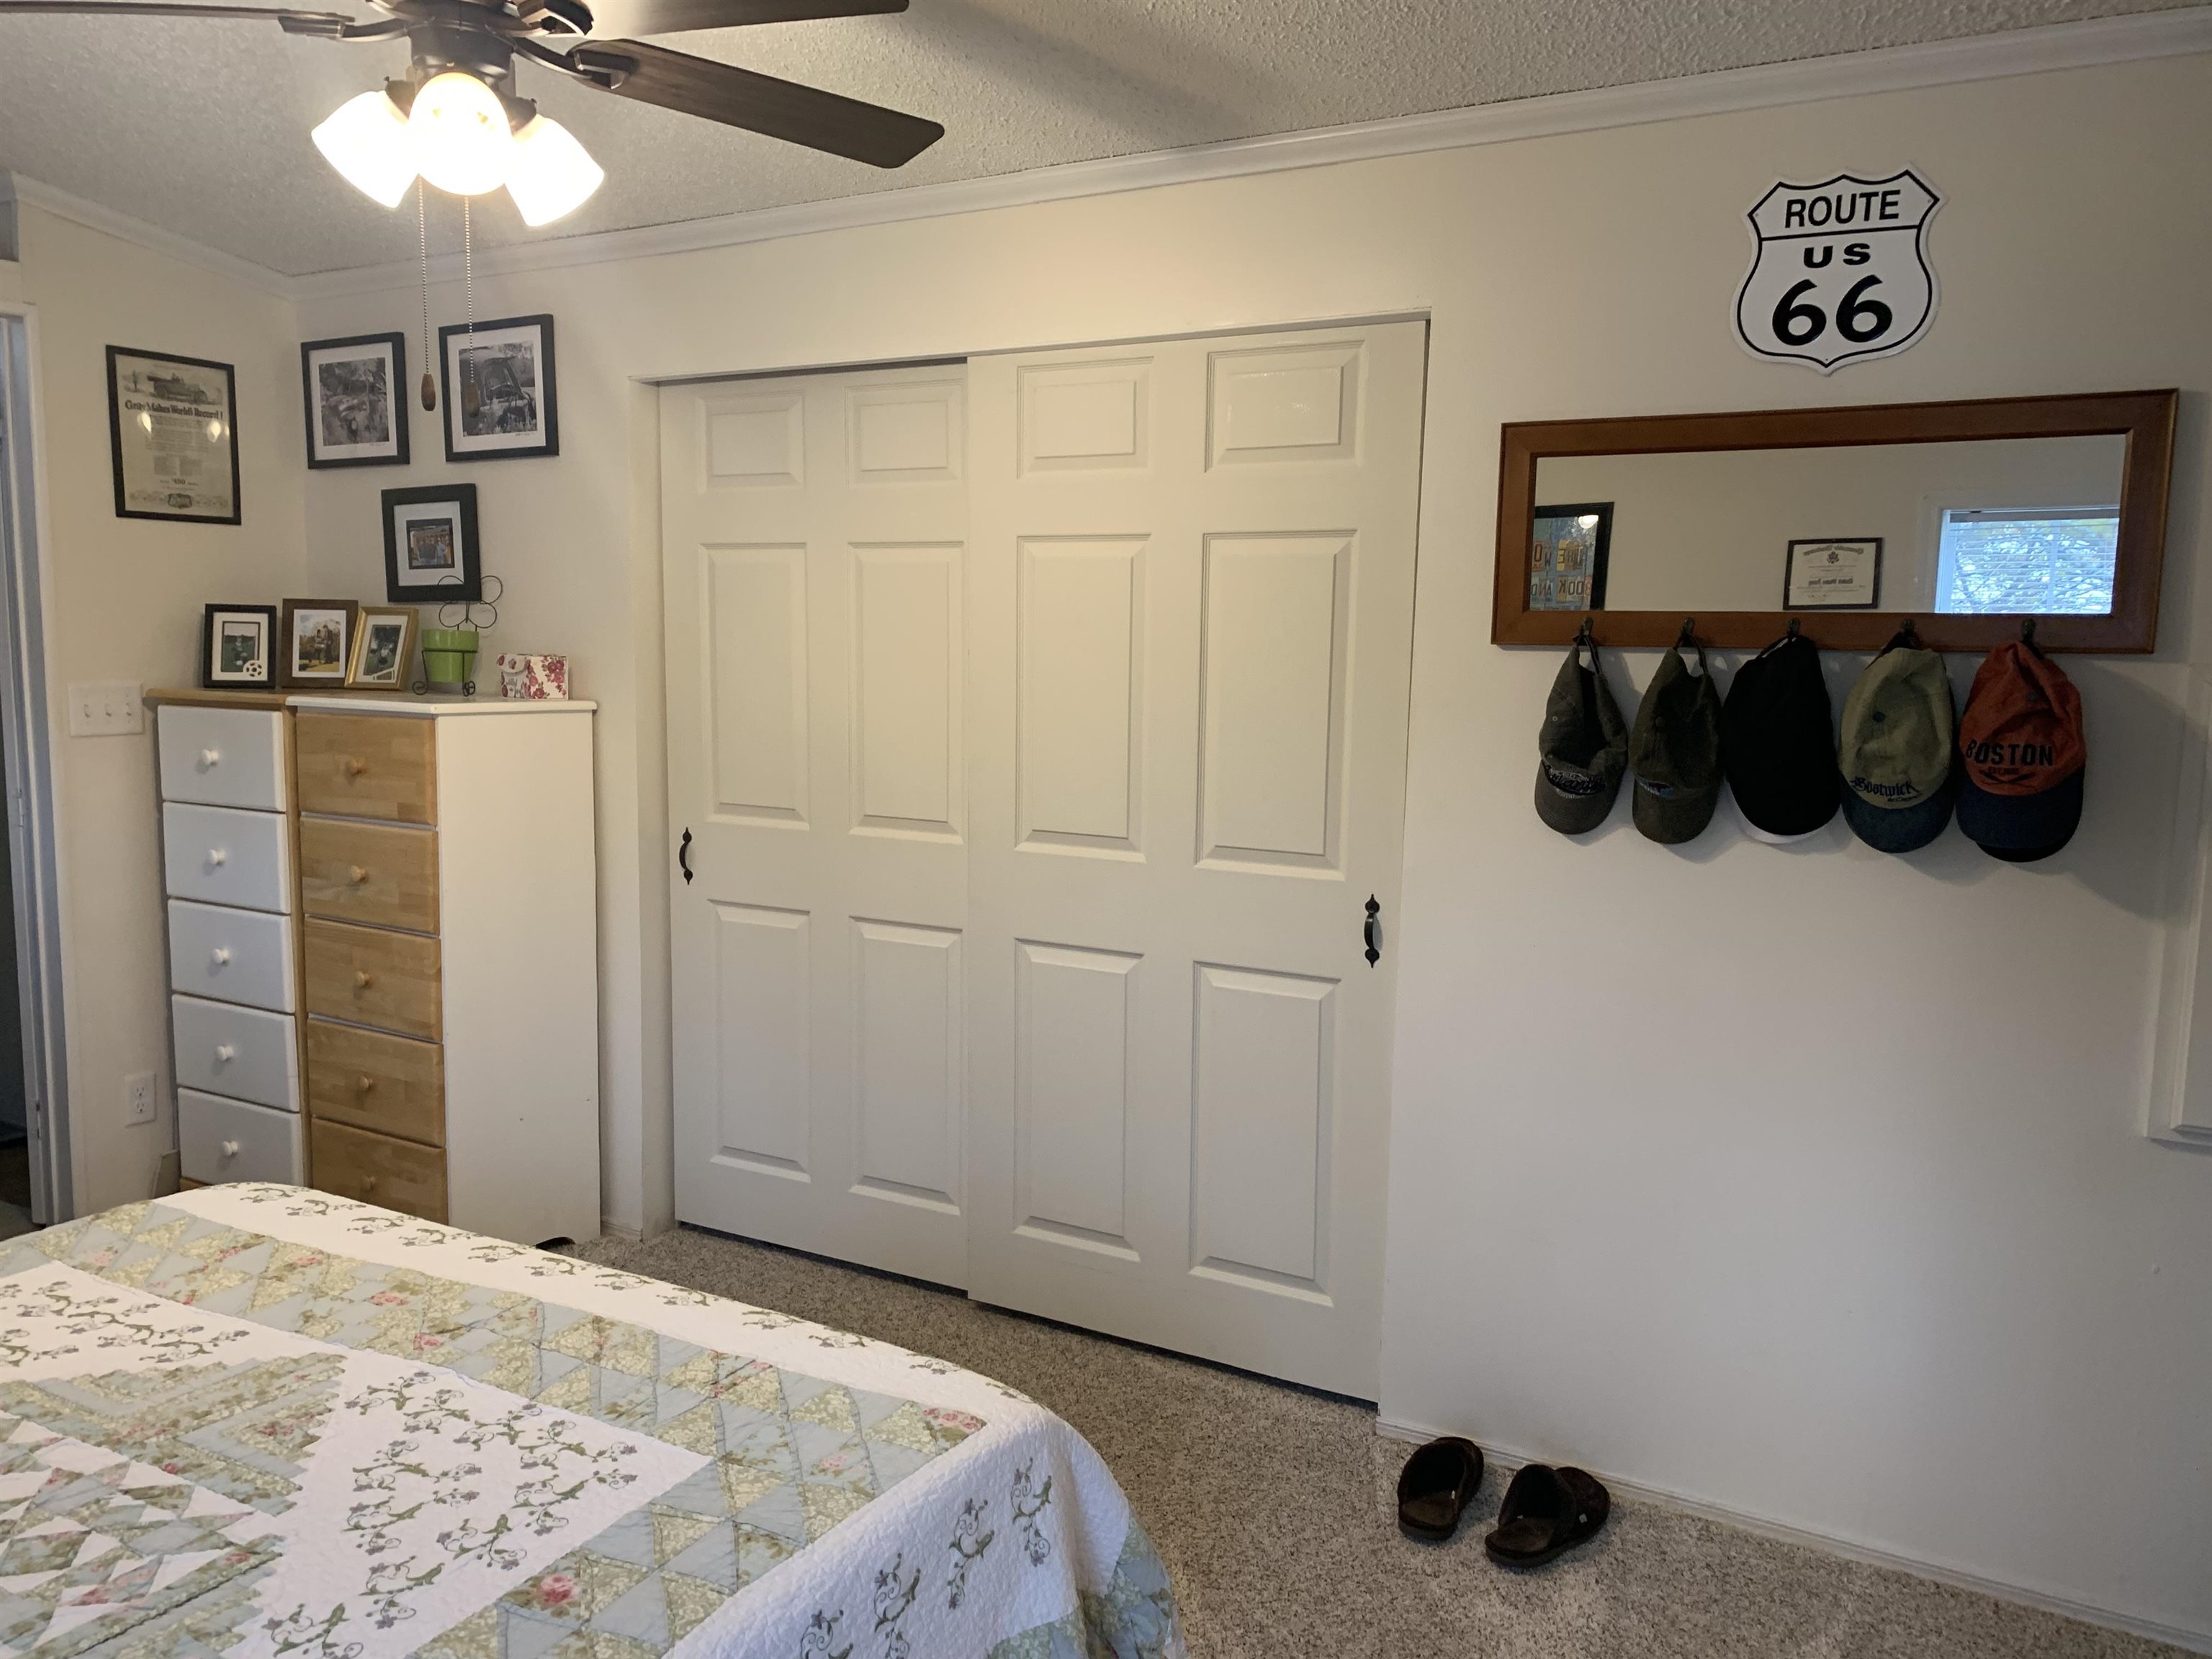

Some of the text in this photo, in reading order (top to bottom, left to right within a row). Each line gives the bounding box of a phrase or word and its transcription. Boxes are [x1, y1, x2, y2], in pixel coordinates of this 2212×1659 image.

[1784, 189, 1902, 229] ROUTE
[1803, 242, 1871, 269] US
[1771, 274, 1893, 346] 66
[1965, 738, 2054, 767] BOSTON
